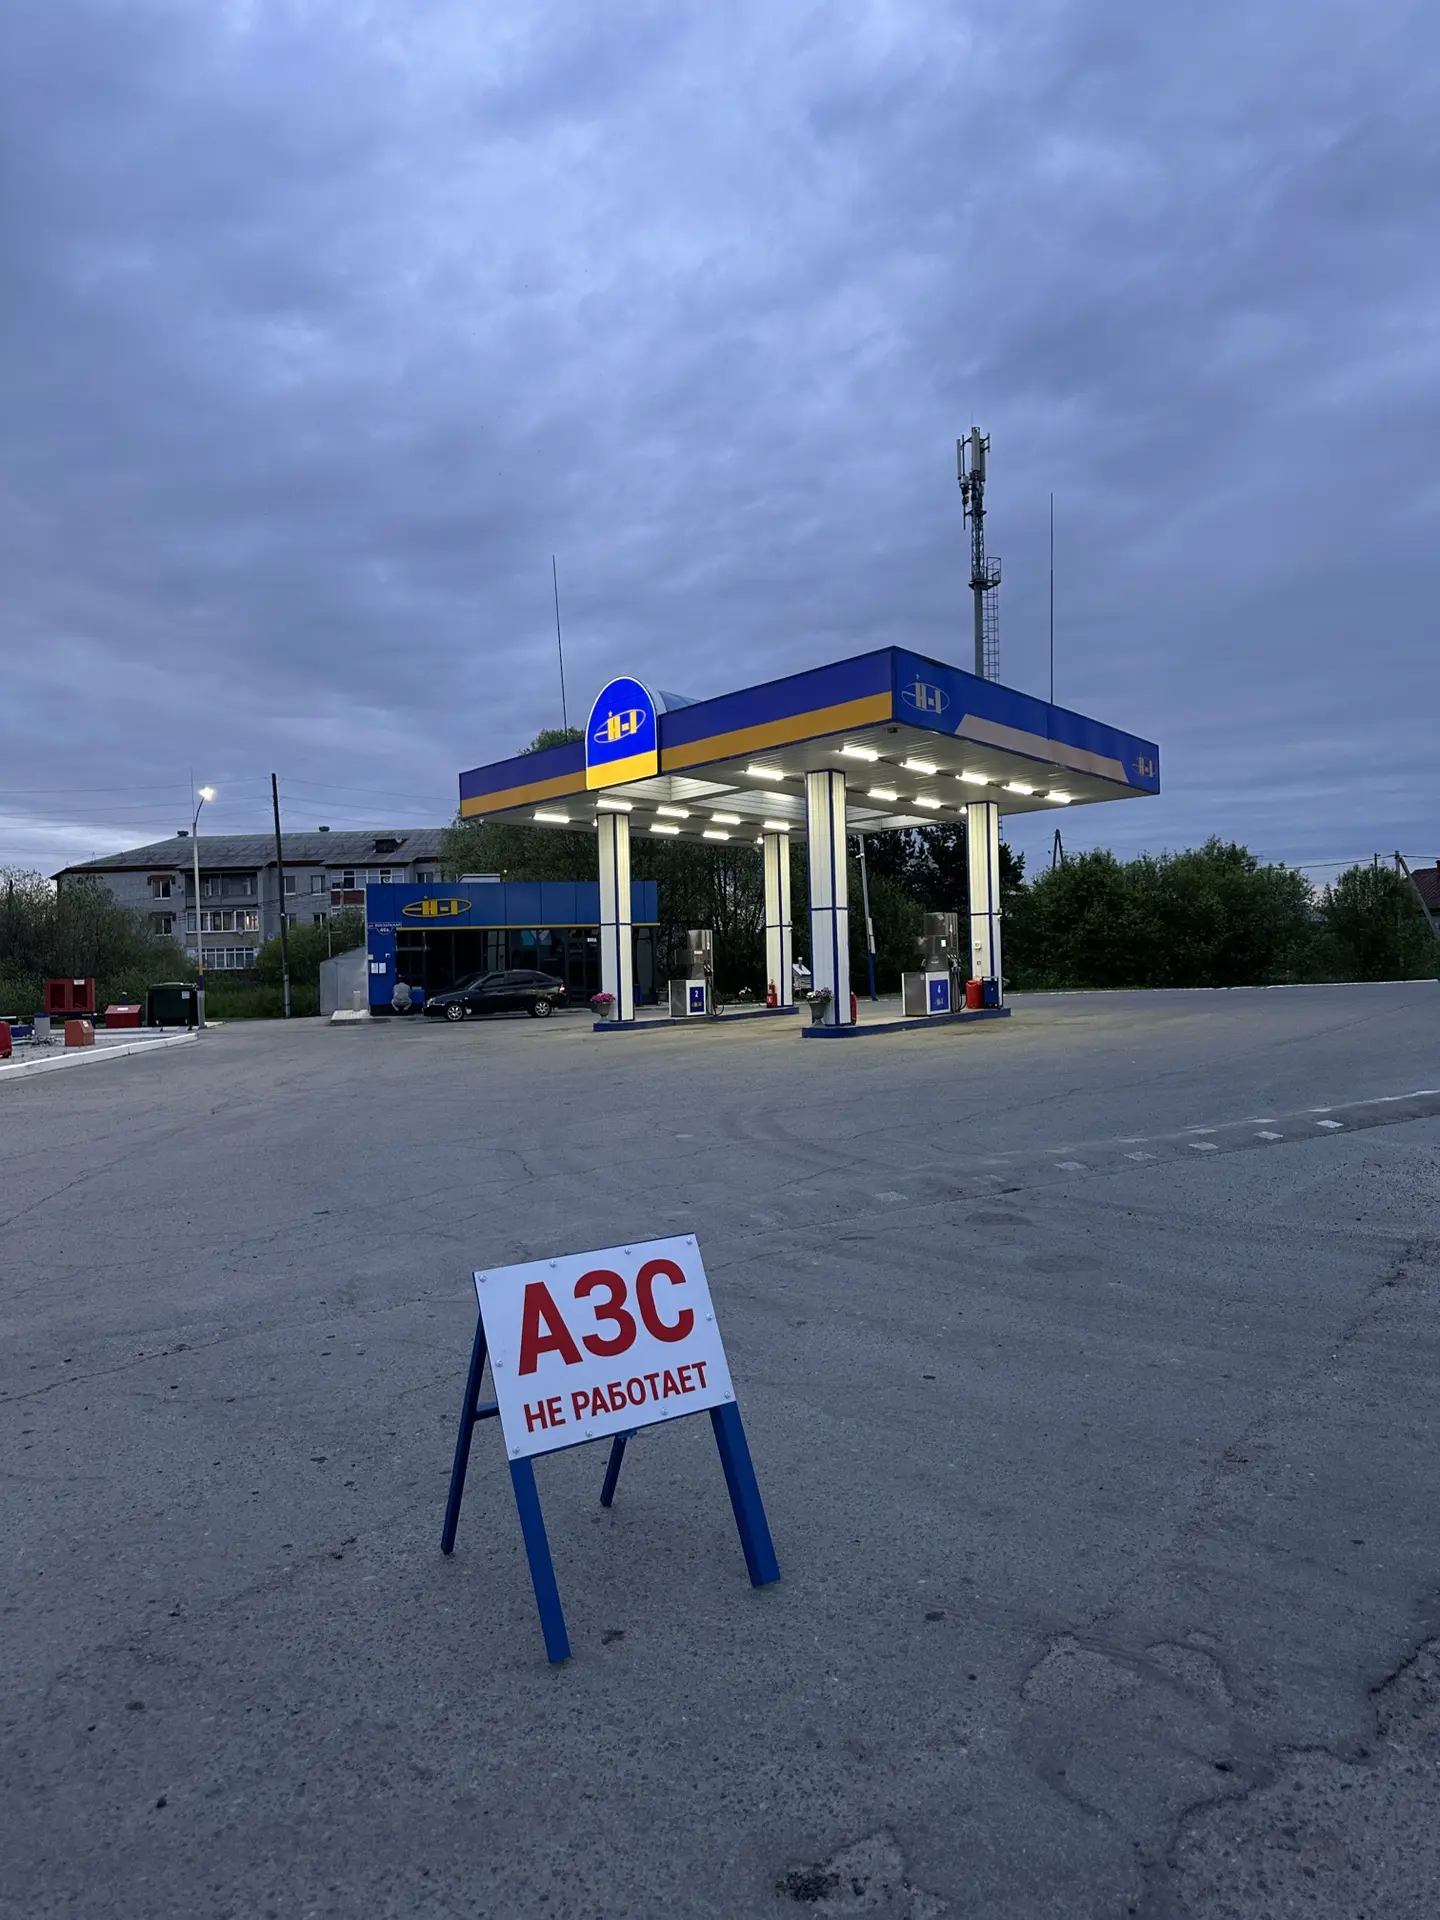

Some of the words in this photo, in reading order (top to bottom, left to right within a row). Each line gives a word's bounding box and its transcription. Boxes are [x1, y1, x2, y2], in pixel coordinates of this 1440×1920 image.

[694, 990, 699, 998] 2
[518, 1258, 694, 1377] АЗС
[523, 1396, 566, 1433] НЕ
[571, 1361, 708, 1421] РАБОТАЕТ
